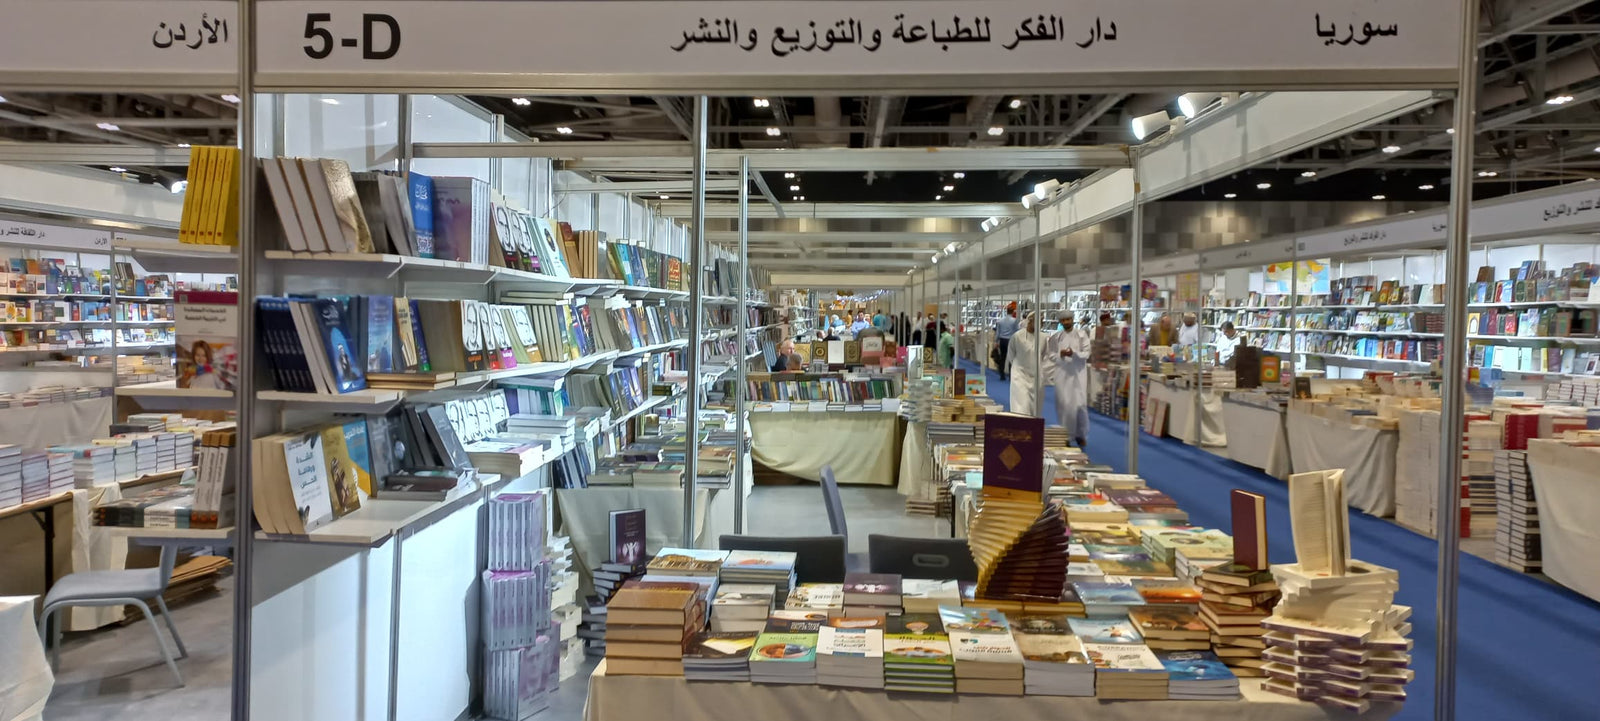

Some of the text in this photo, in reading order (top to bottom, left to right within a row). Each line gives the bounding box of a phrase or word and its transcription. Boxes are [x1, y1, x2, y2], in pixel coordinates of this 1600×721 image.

[152, 12, 229, 50] الأردن
[303, 12, 402, 61] 5-D
[670, 13, 1117, 58] دار الفكر للطباعة والتوزيع والنشر
[1314, 13, 1398, 47] سوريا
